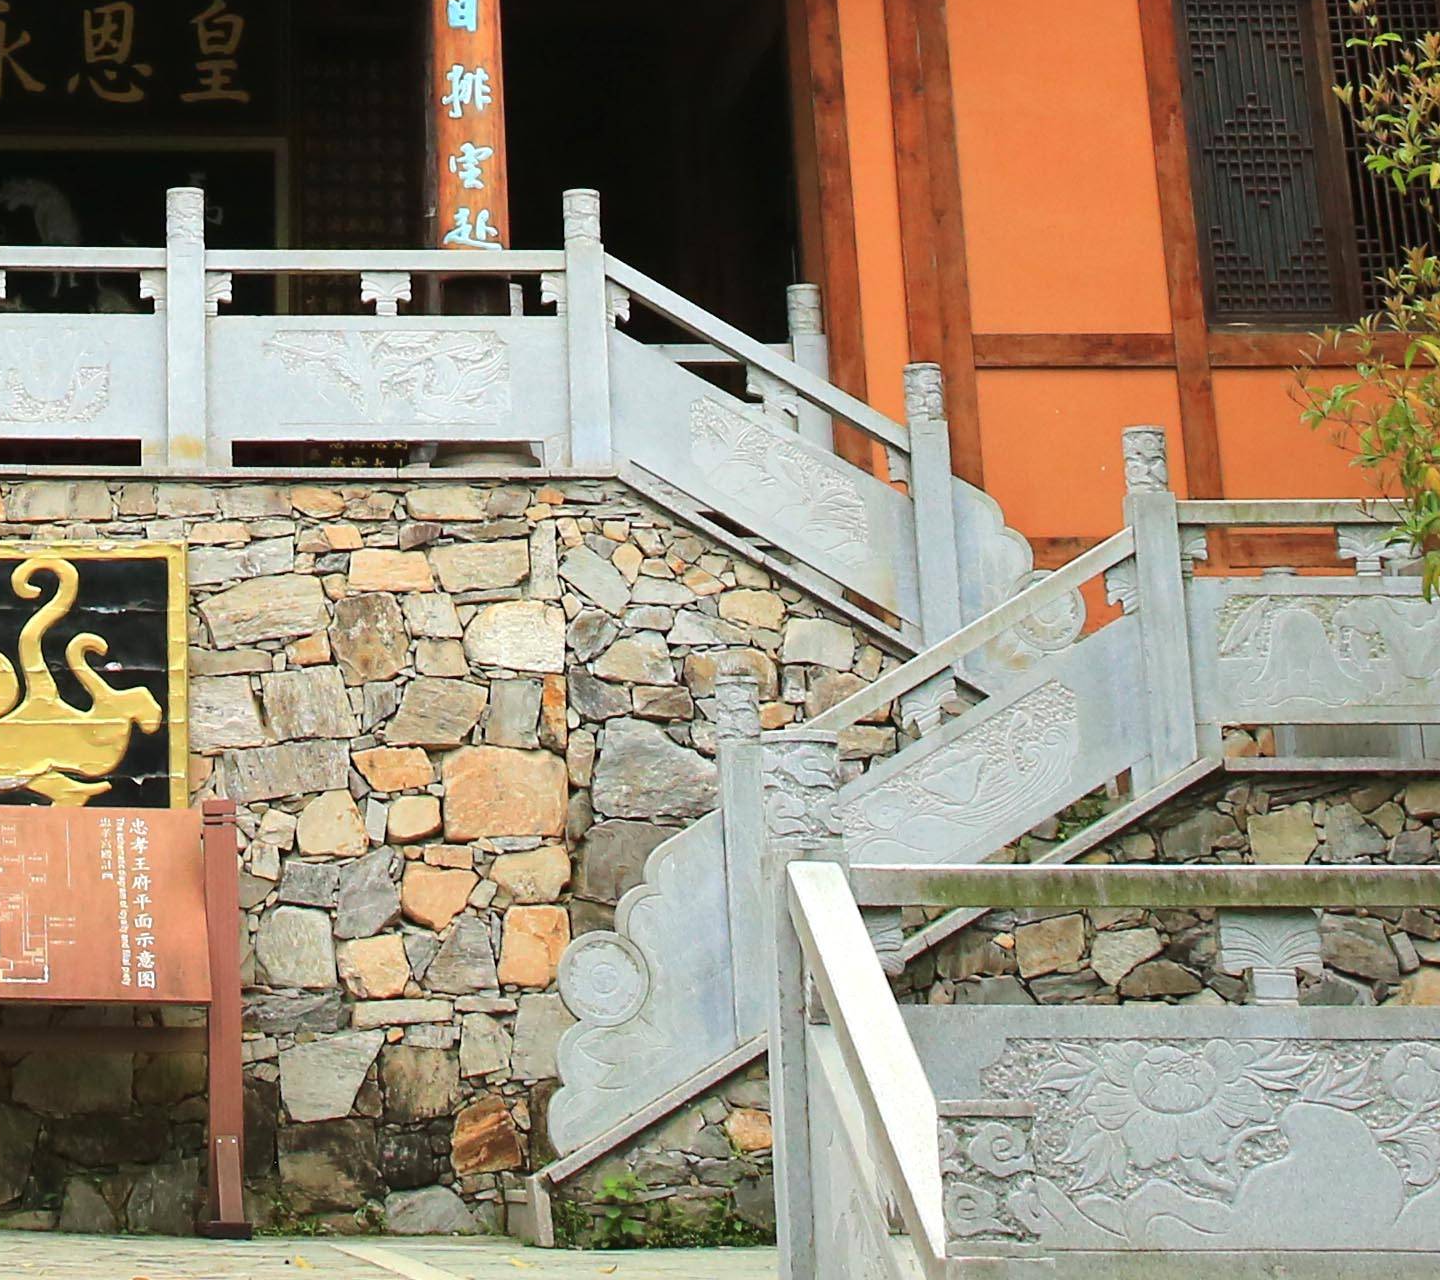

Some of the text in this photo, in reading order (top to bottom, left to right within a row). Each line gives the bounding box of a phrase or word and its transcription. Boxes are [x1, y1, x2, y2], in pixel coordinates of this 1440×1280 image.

[128, 818, 156, 989] 忠孝王府平面示意图
